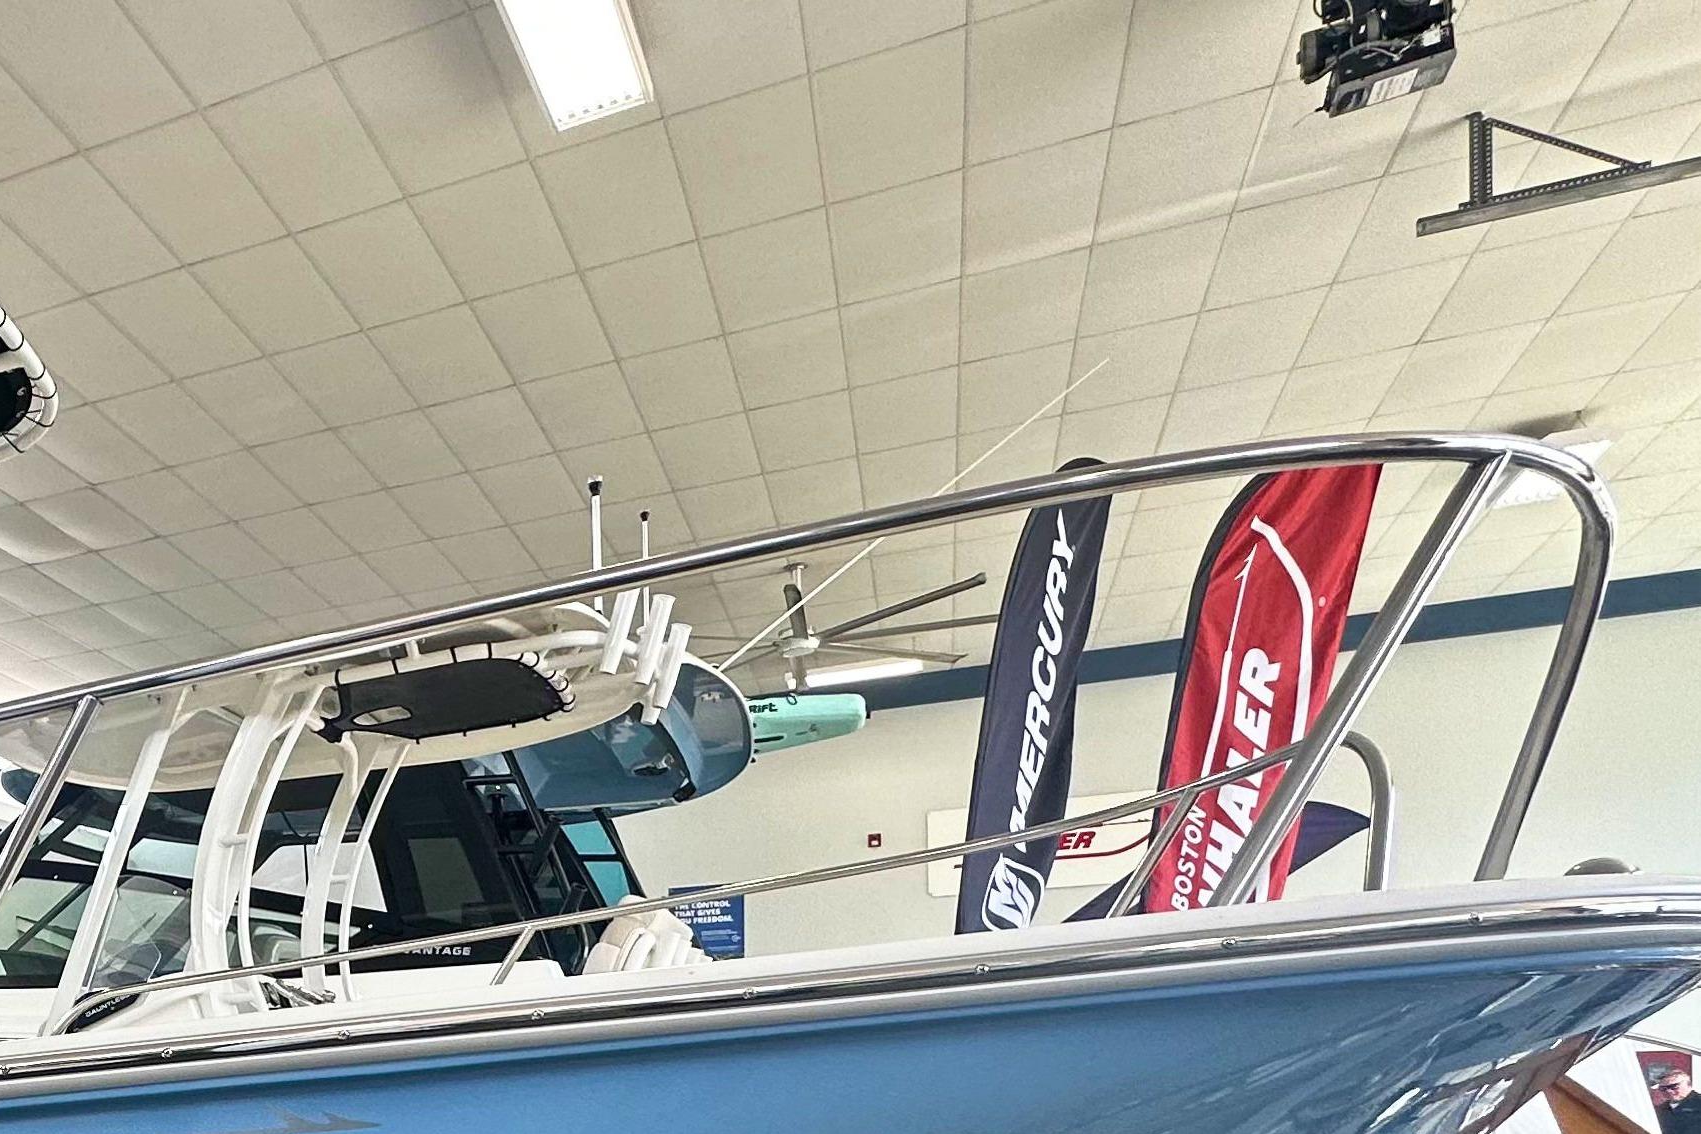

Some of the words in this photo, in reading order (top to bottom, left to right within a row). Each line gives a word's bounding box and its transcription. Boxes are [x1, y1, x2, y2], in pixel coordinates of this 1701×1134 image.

[1010, 508, 1074, 853] MERCURY
[1171, 804, 1207, 912] BOSTON
[691, 900, 732, 909] CONTROL
[403, 945, 472, 956] ANTAGE
